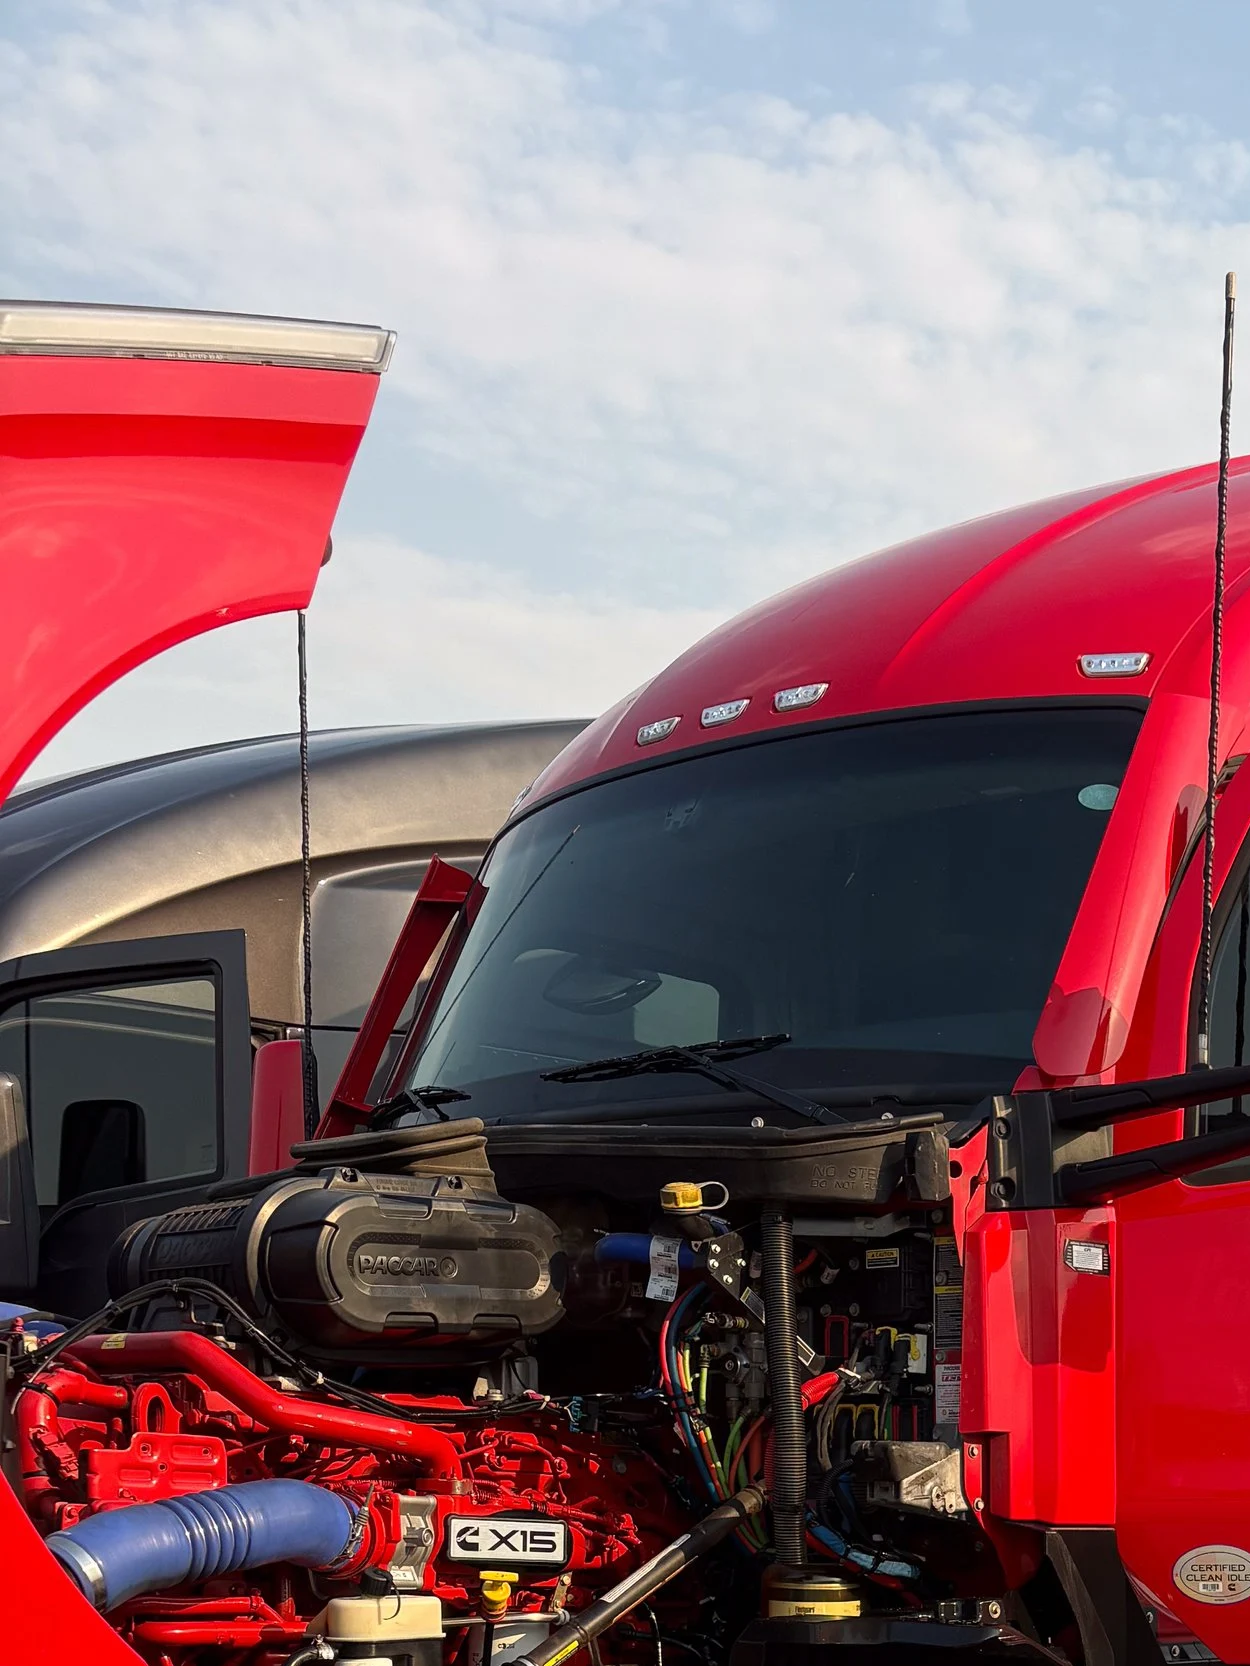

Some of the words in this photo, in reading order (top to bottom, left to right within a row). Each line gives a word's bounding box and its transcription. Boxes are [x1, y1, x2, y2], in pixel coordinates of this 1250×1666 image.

[358, 1254, 439, 1278] PACCAR
[488, 1529, 557, 1552] X15
[1190, 1564, 1246, 1572] CERTIFIED
[1185, 1574, 1222, 1582] CLEAN
[1227, 1574, 1250, 1582] IDLE
